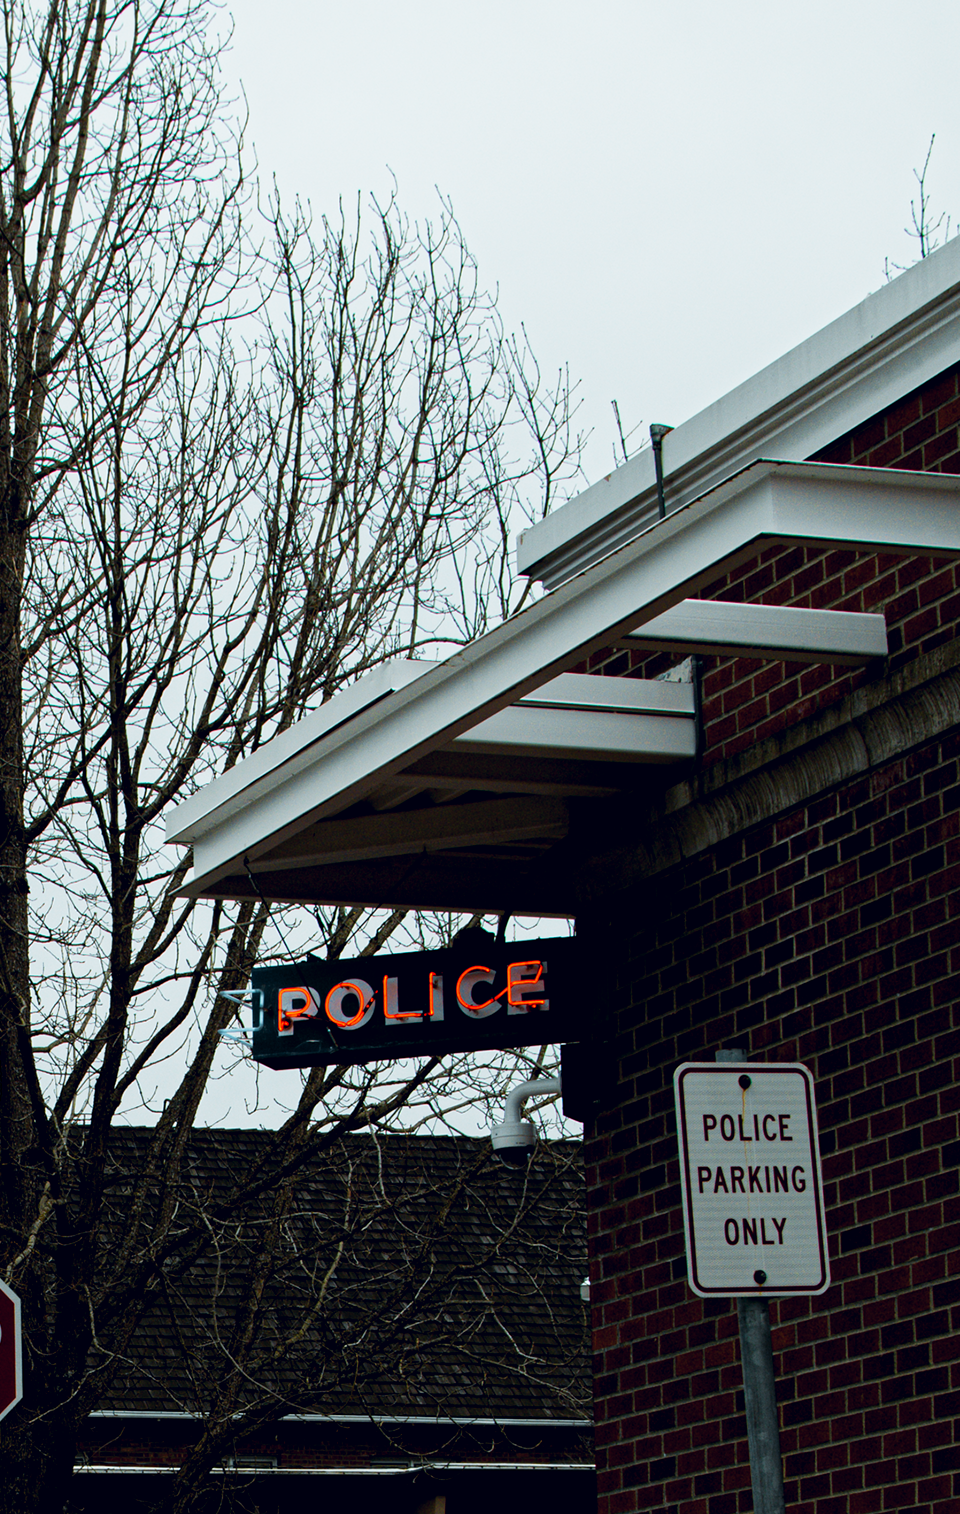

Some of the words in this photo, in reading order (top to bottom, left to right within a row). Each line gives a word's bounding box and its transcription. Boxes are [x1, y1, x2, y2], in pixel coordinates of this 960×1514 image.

[278, 960, 550, 1037] POLICE
[702, 1113, 793, 1141] POLICE
[697, 1165, 806, 1193] PARKING
[724, 1217, 787, 1246] ONLY
